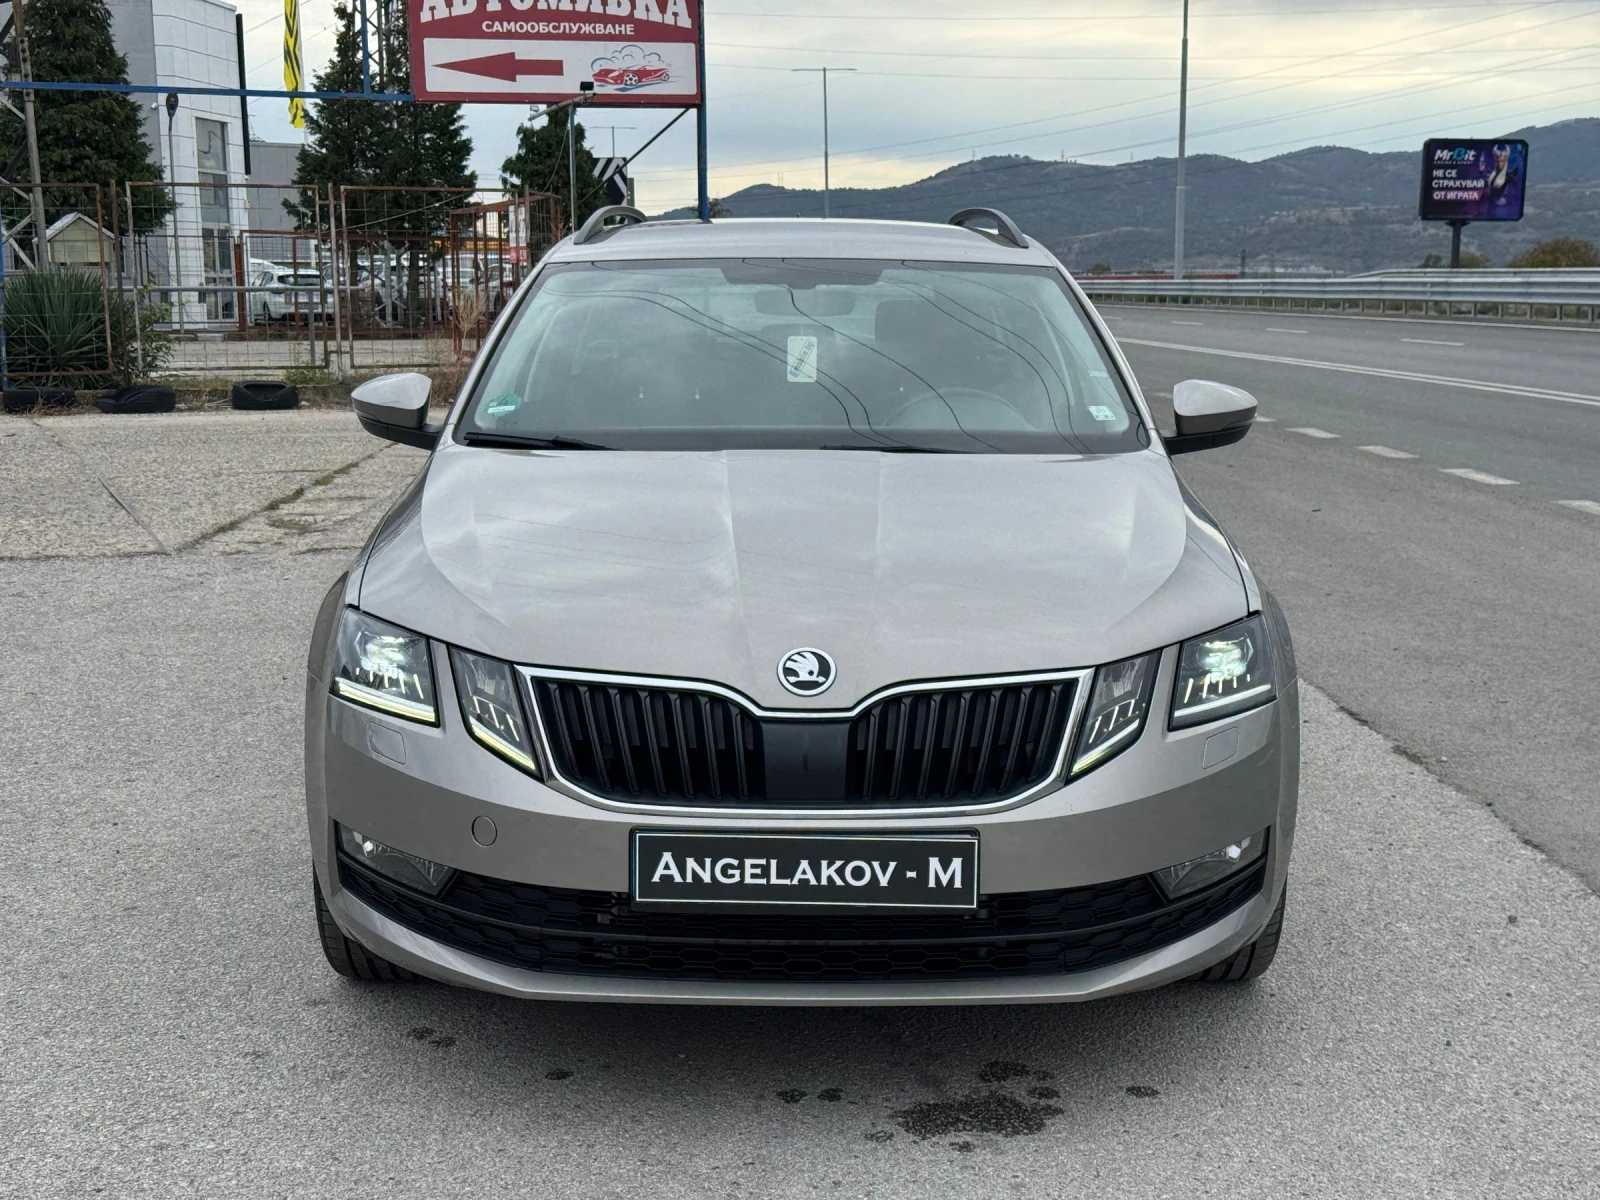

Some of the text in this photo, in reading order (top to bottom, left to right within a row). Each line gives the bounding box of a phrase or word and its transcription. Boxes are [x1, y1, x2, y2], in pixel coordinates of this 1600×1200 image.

[482, 21, 635, 35] САМООБСЛУЖВАНЕ
[1434, 147, 1476, 160] MrBit
[1433, 169, 1457, 178] НЕ СЕ
[1432, 179, 1485, 188] СТРАХУВАЙ
[1433, 191, 1479, 200] ОТ ИГРАТА
[927, 856, 964, 889] M
